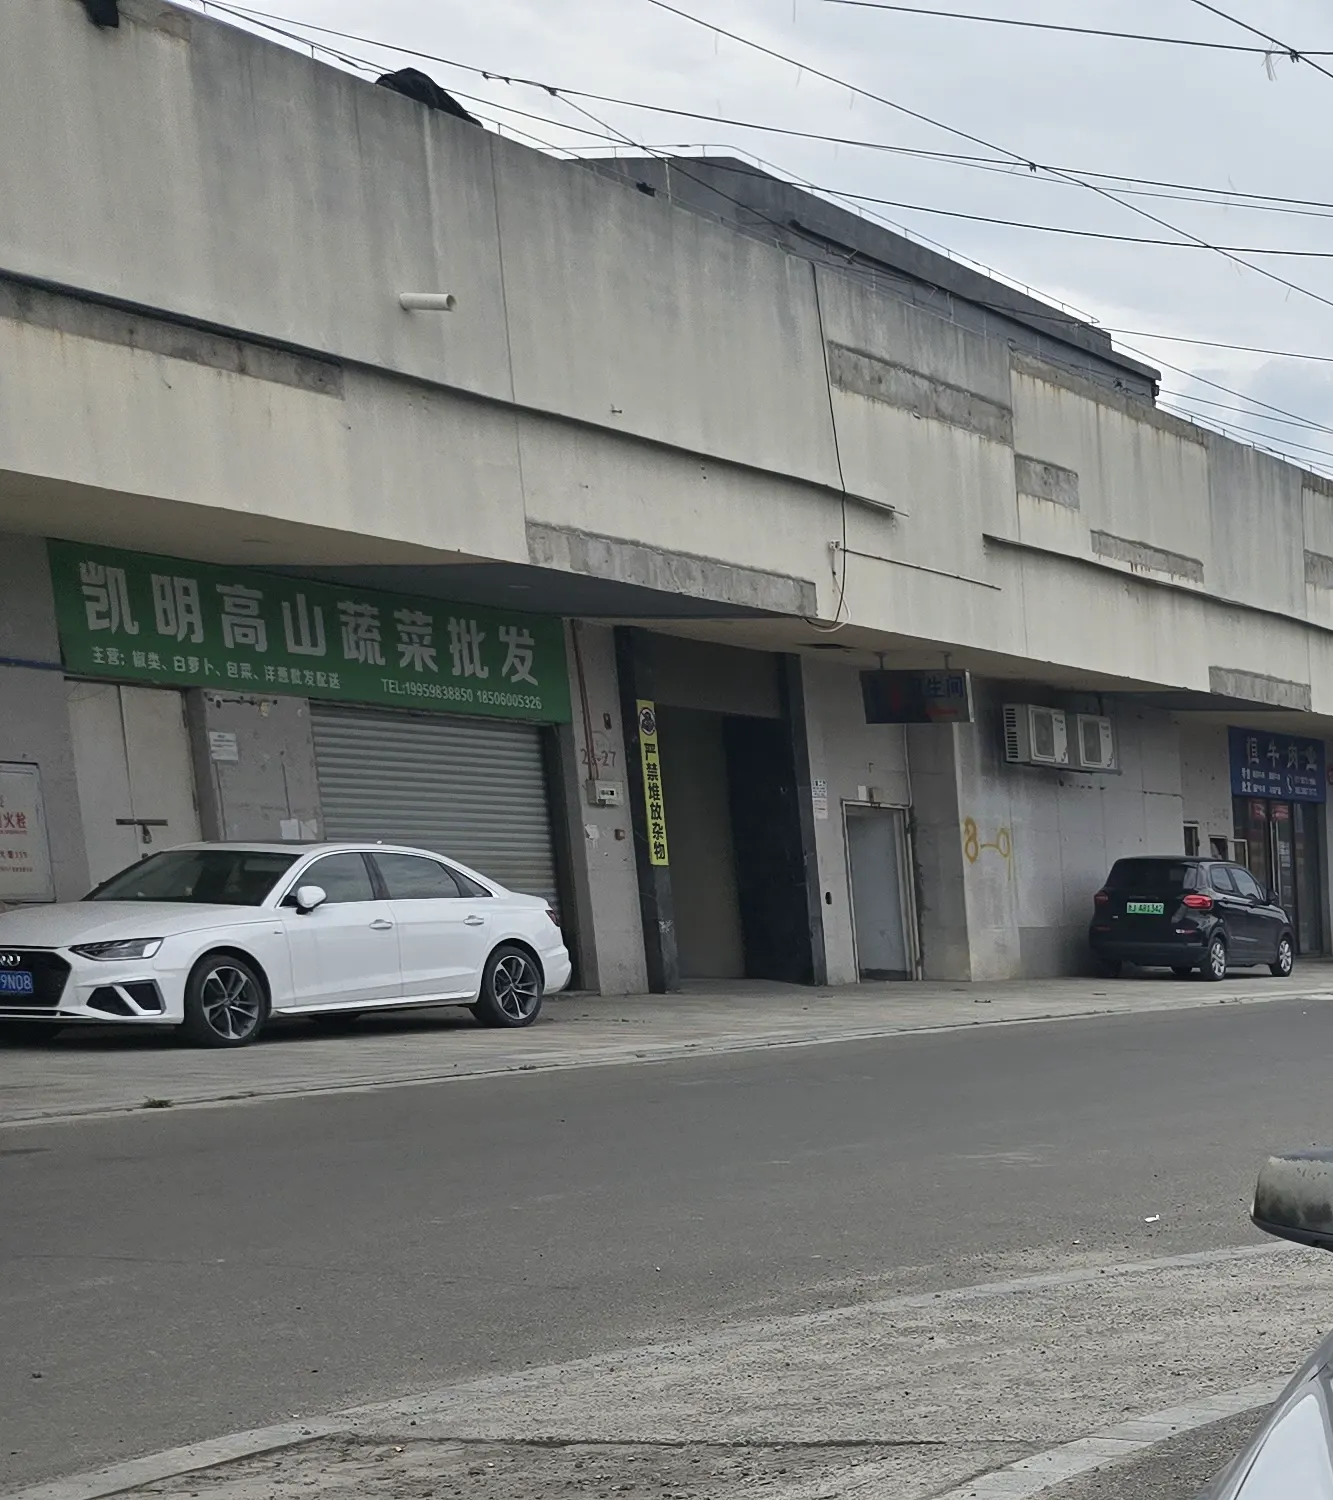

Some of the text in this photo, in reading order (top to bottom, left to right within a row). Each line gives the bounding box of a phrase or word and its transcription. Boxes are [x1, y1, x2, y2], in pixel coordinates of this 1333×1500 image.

[79, 560, 538, 686] 凯明高山蔬菜批发
[0, 811, 27, 829] 火栓
[644, 743, 666, 860] 严禁堆放杂物
